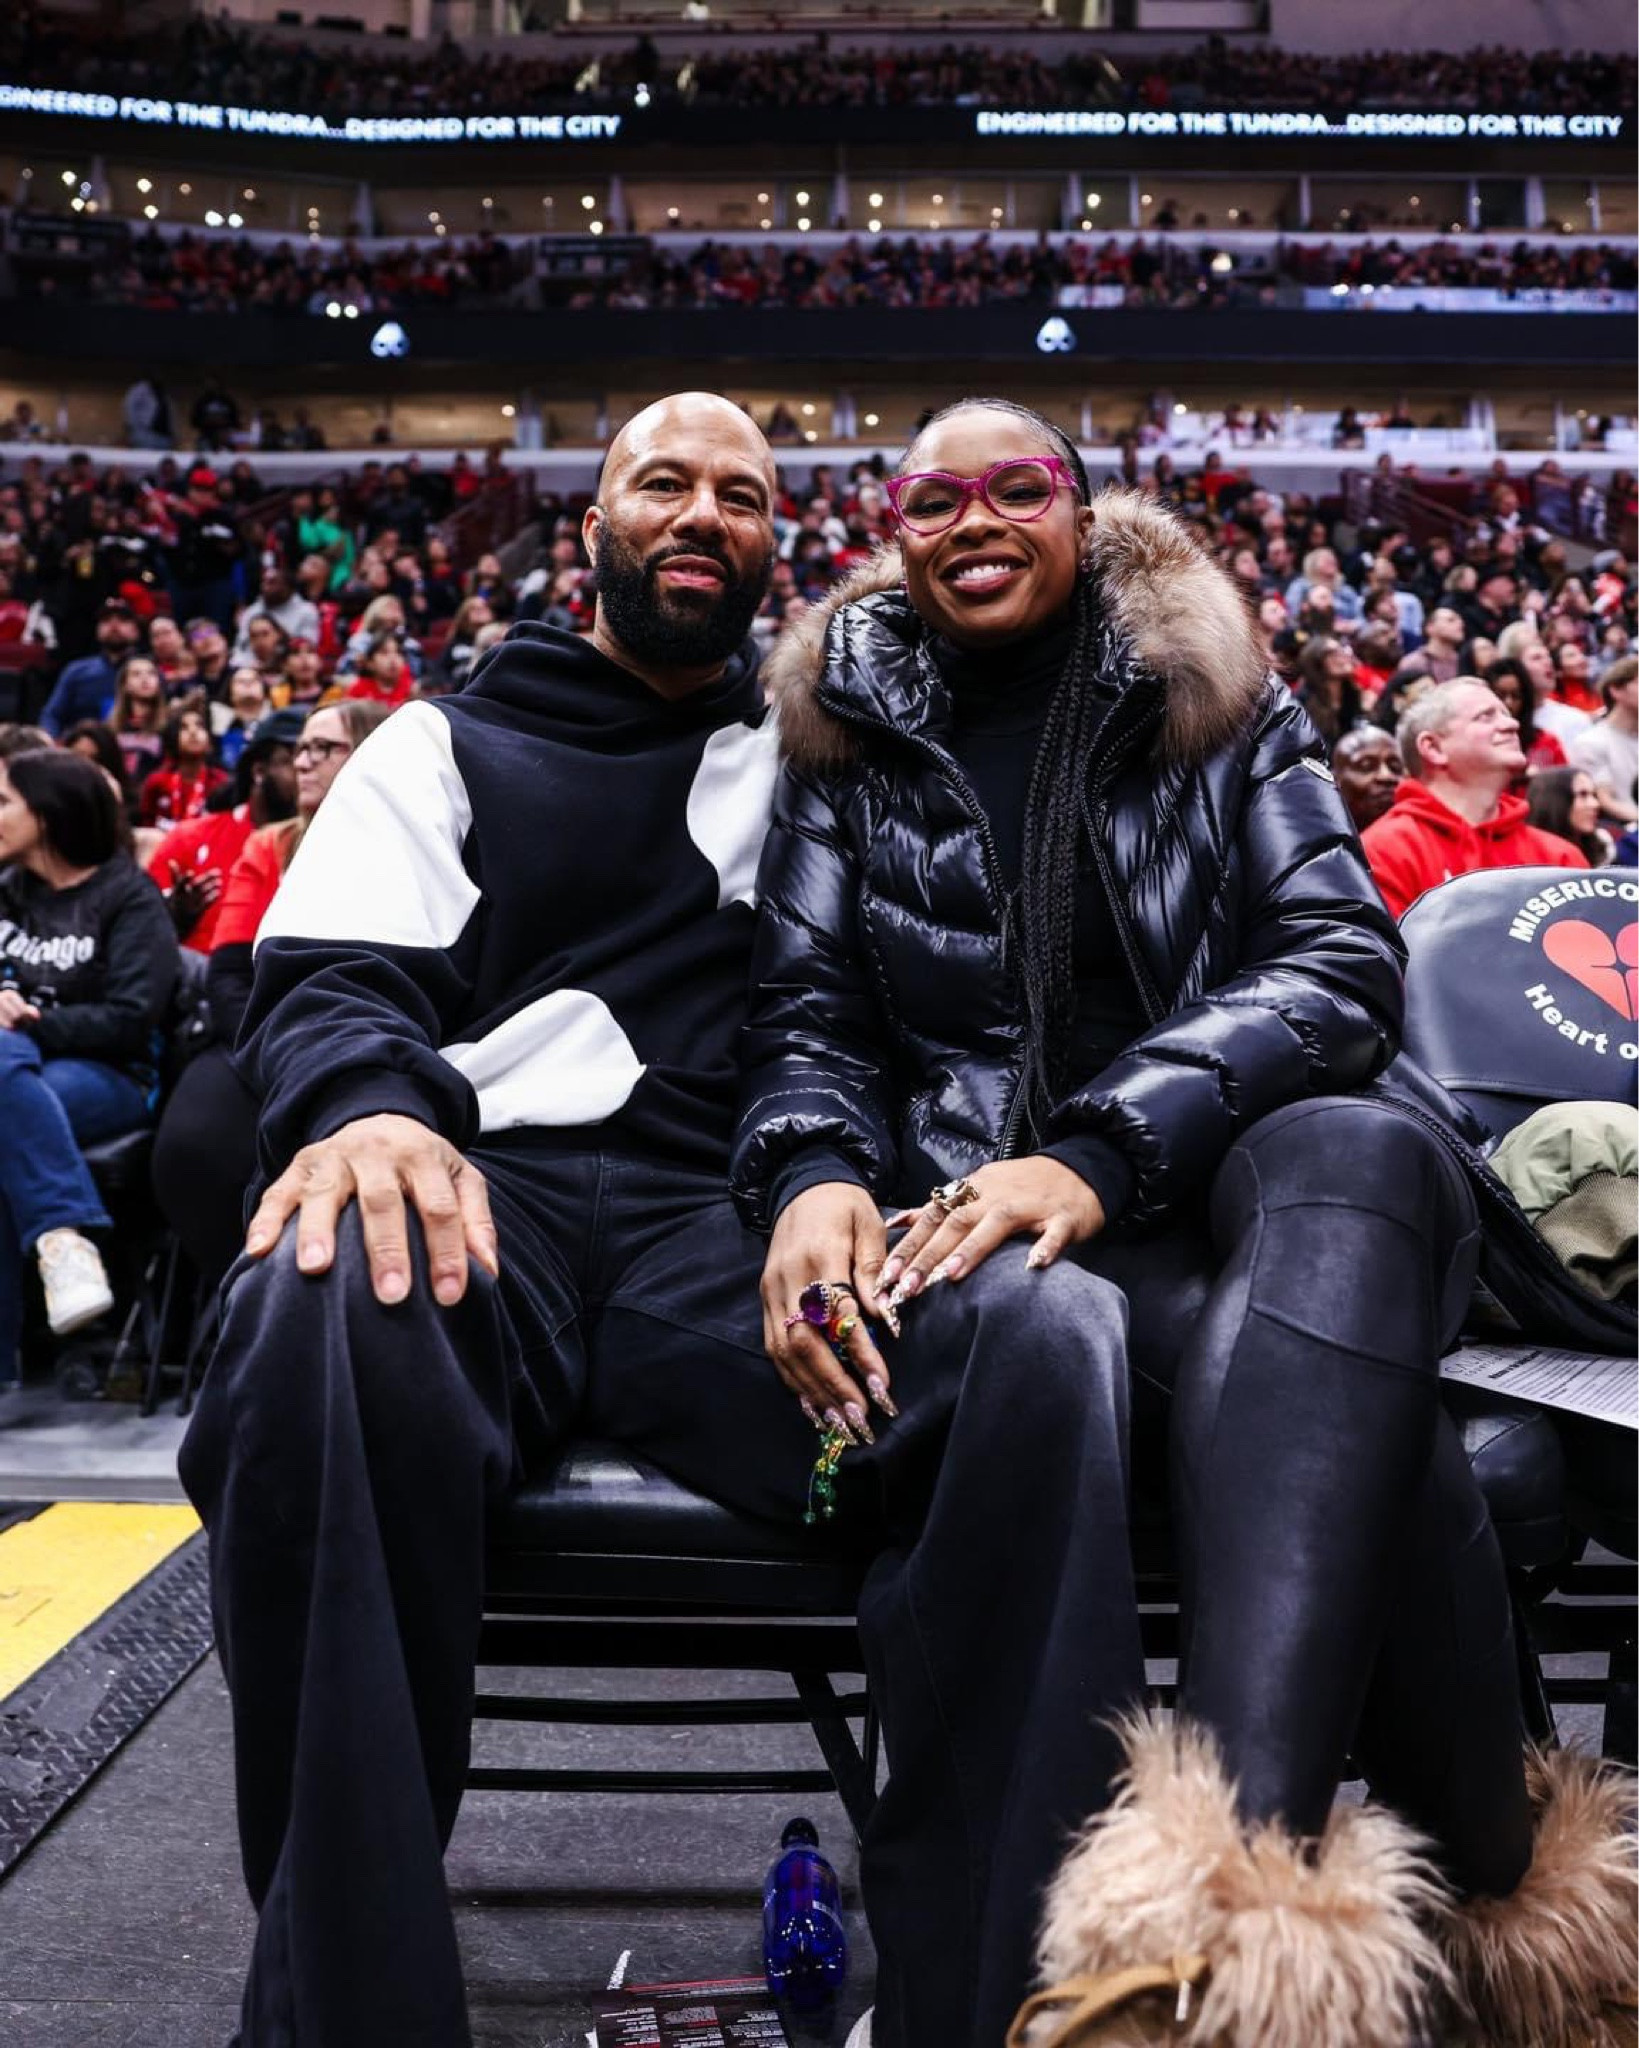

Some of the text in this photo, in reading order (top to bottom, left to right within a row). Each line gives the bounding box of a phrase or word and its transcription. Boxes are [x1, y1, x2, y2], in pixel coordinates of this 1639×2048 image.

[120, 97, 172, 122] FOR
[176, 102, 223, 128] THE
[467, 117, 515, 138] FOR
[518, 116, 565, 138] THE
[567, 116, 620, 138] CITY
[977, 111, 1126, 134] ENGINEERED
[1128, 112, 1178, 134] FOR
[1179, 113, 1227, 135] THE
[1468, 114, 1518, 136] FOR
[1519, 115, 1567, 136] THE
[1568, 116, 1622, 137] CITY
[1508, 879, 1639, 943] MISERICO
[1524, 983, 1608, 1054] Heart
